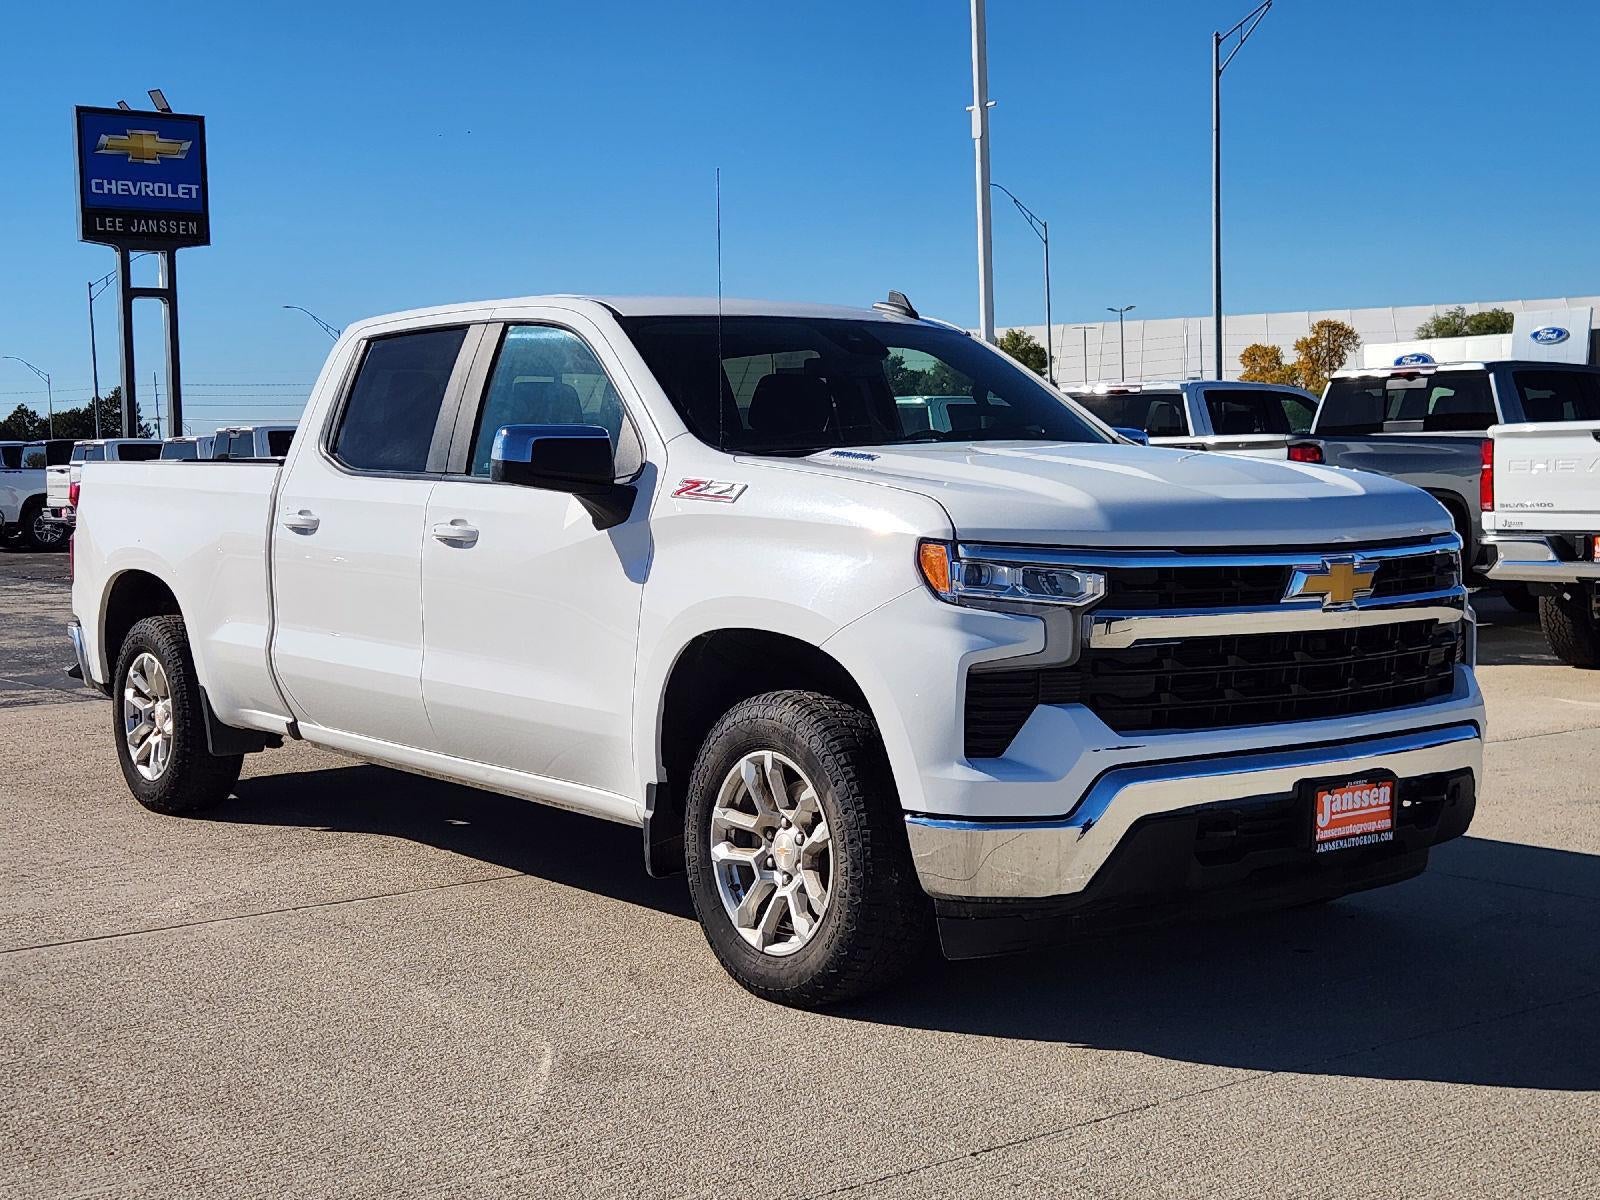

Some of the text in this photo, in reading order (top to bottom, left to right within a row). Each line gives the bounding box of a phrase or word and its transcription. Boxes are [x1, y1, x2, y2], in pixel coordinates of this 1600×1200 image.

[91, 178, 199, 199] CHEVROLET
[95, 217, 197, 235] LEE JANSSEN
[1316, 784, 1391, 828] Janssen
[1316, 832, 1394, 854] JANSSENAUTOGROUP.COM
